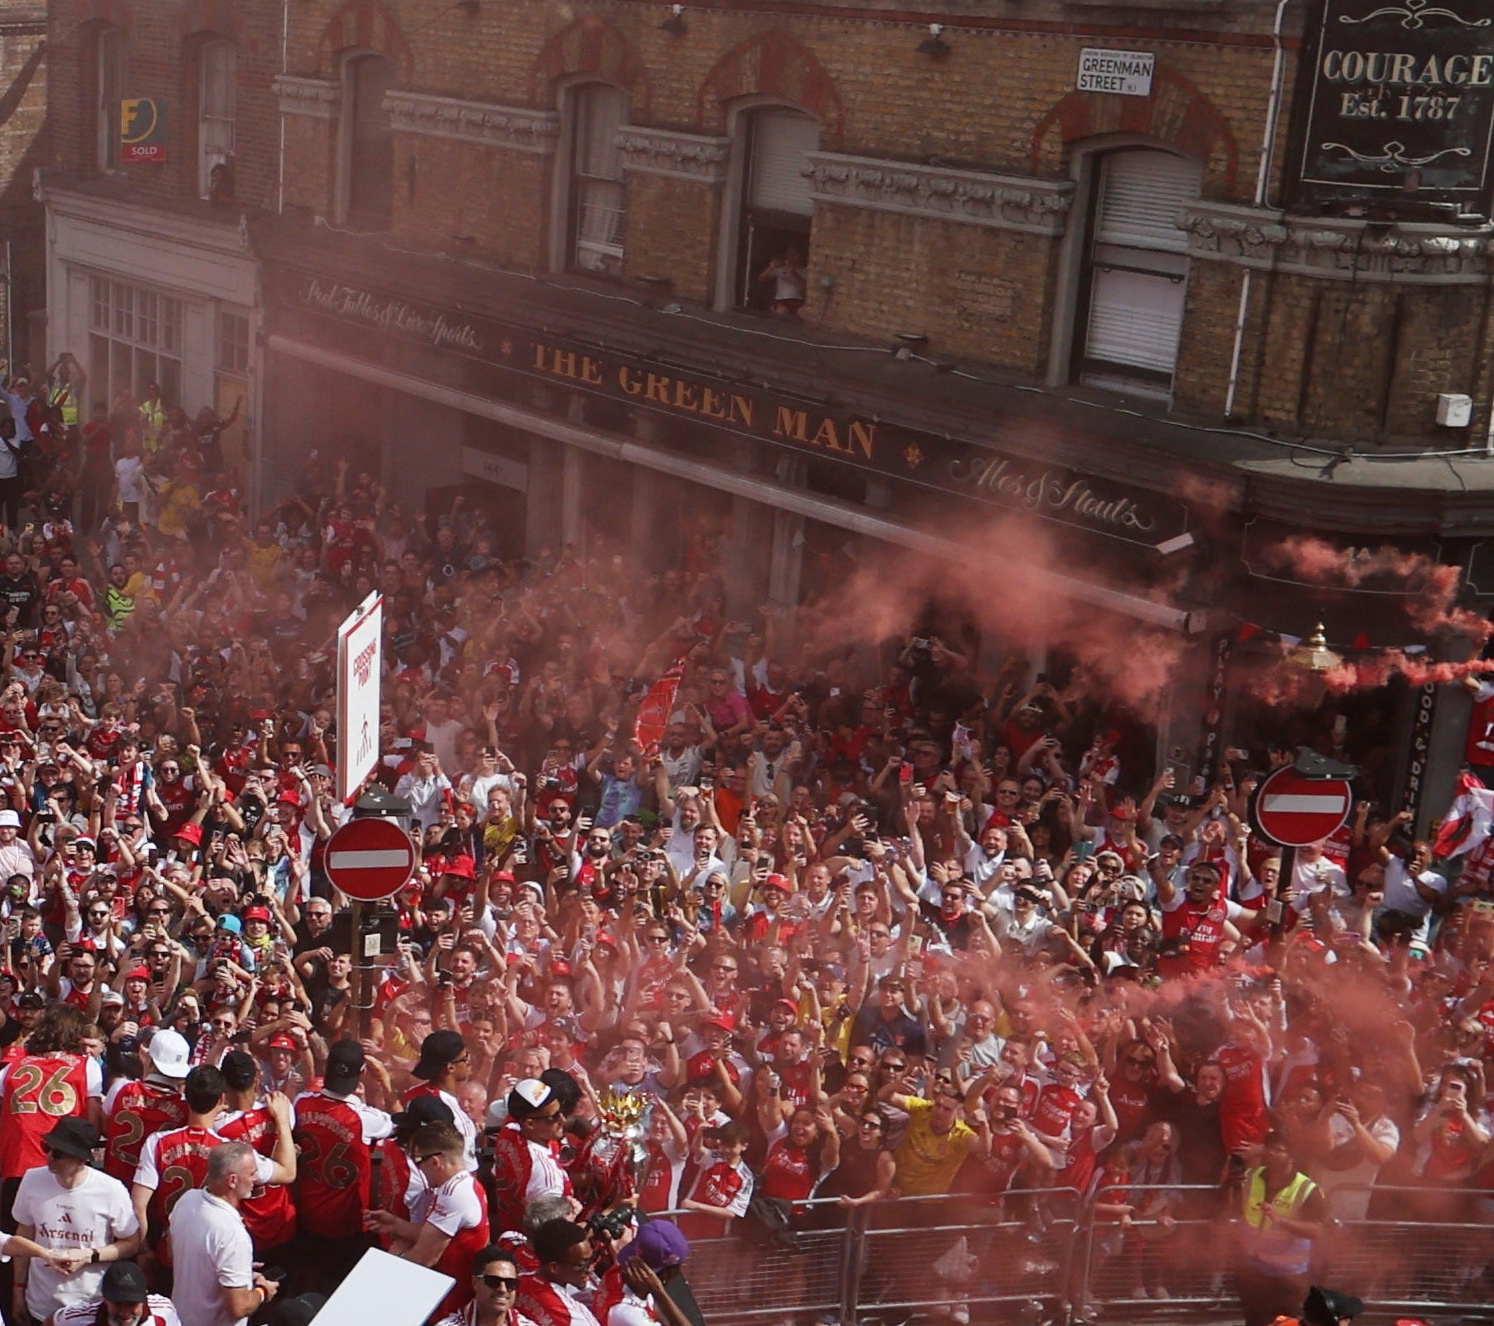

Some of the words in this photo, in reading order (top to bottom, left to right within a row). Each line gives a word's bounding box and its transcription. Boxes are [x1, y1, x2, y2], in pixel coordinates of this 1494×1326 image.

[1082, 57, 1151, 77] GREENMAN
[1322, 49, 1494, 85] COURAGE
[1080, 74, 1126, 91] STREET
[1340, 93, 1388, 119] Est.
[1397, 94, 1459, 119] 1787
[131, 147, 157, 155] SOLD
[533, 344, 603, 385] THE
[619, 366, 752, 426] GREEN
[771, 407, 876, 460] MAN
[1403, 761, 1422, 836] DRIK
[12, 1065, 78, 1115] 26
[39, 1222, 95, 1244] Arsenal
